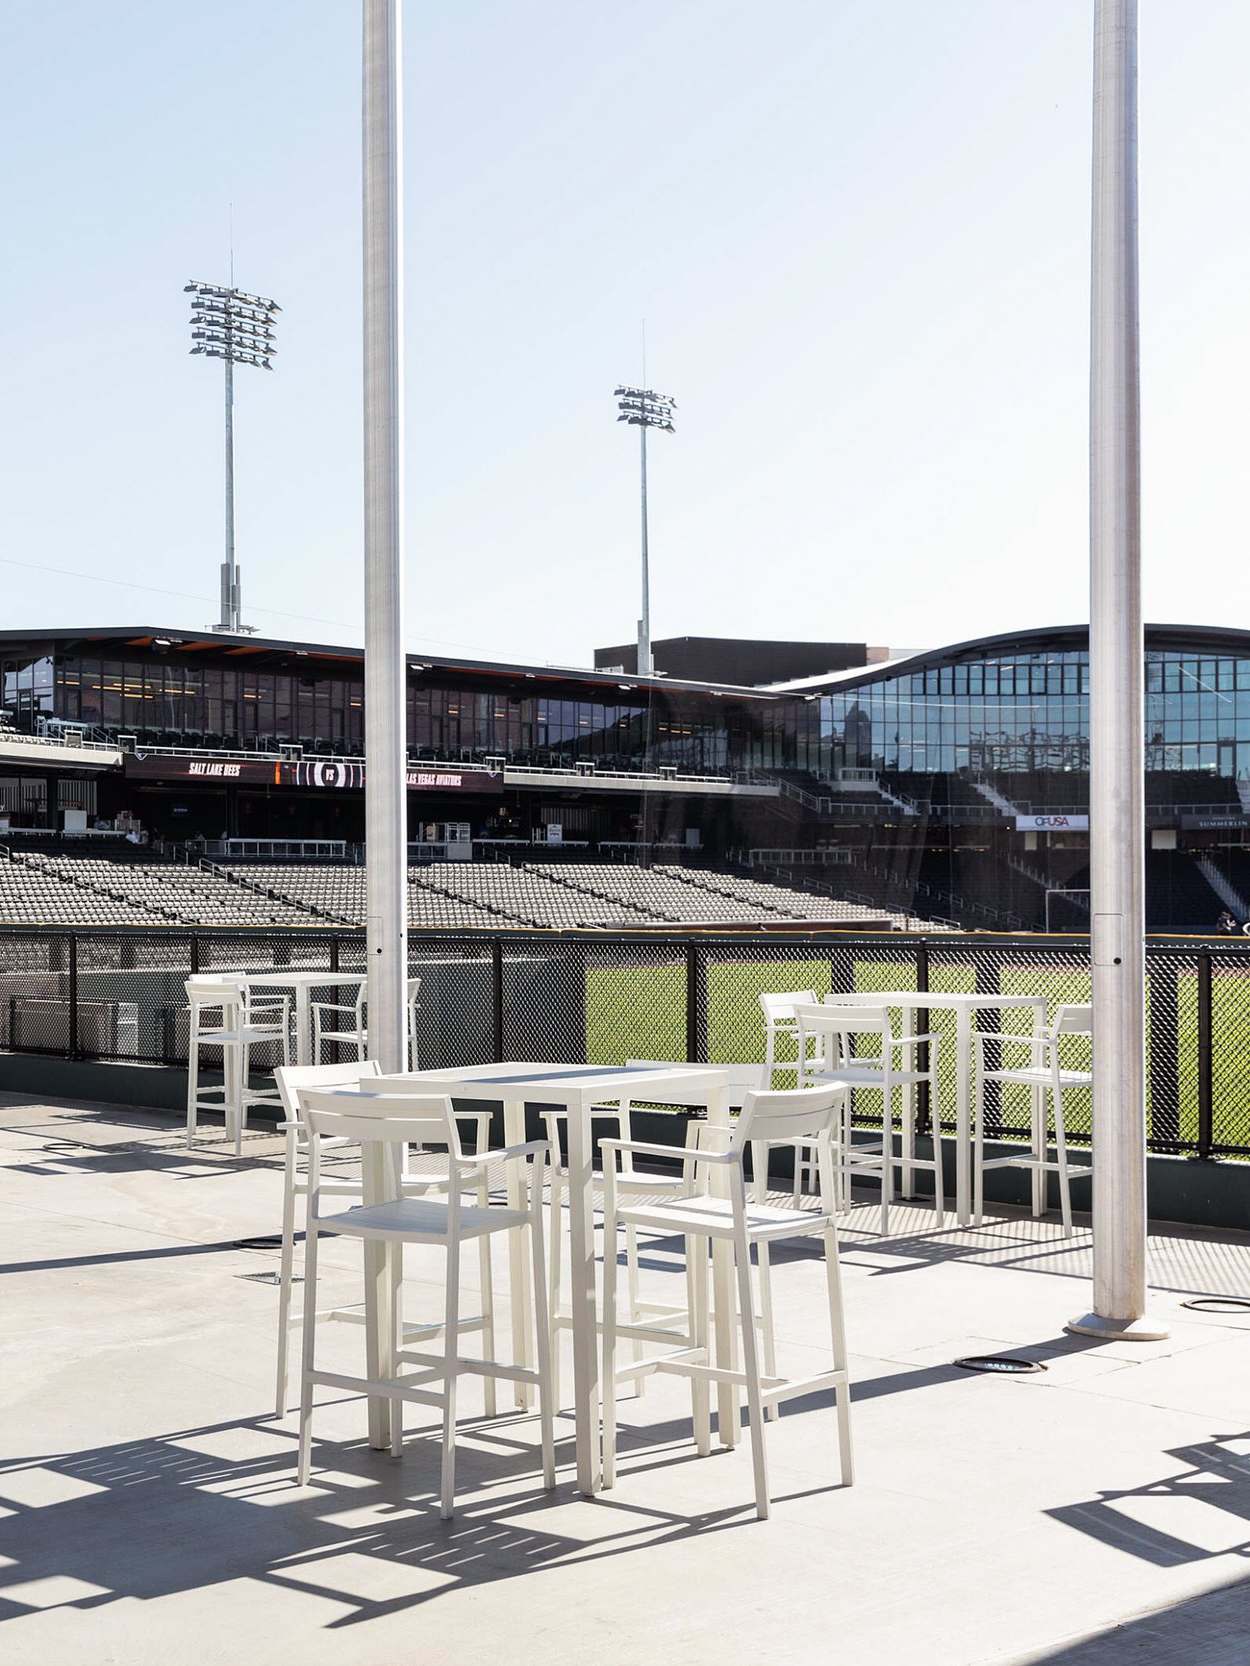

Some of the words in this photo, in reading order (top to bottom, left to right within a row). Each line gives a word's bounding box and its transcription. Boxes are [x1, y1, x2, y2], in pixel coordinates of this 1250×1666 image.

[188, 762, 207, 775] SALT
[206, 763, 224, 776] LAKE
[223, 763, 241, 777] BEES
[326, 769, 335, 780] VS
[417, 773, 436, 786] VEGAS
